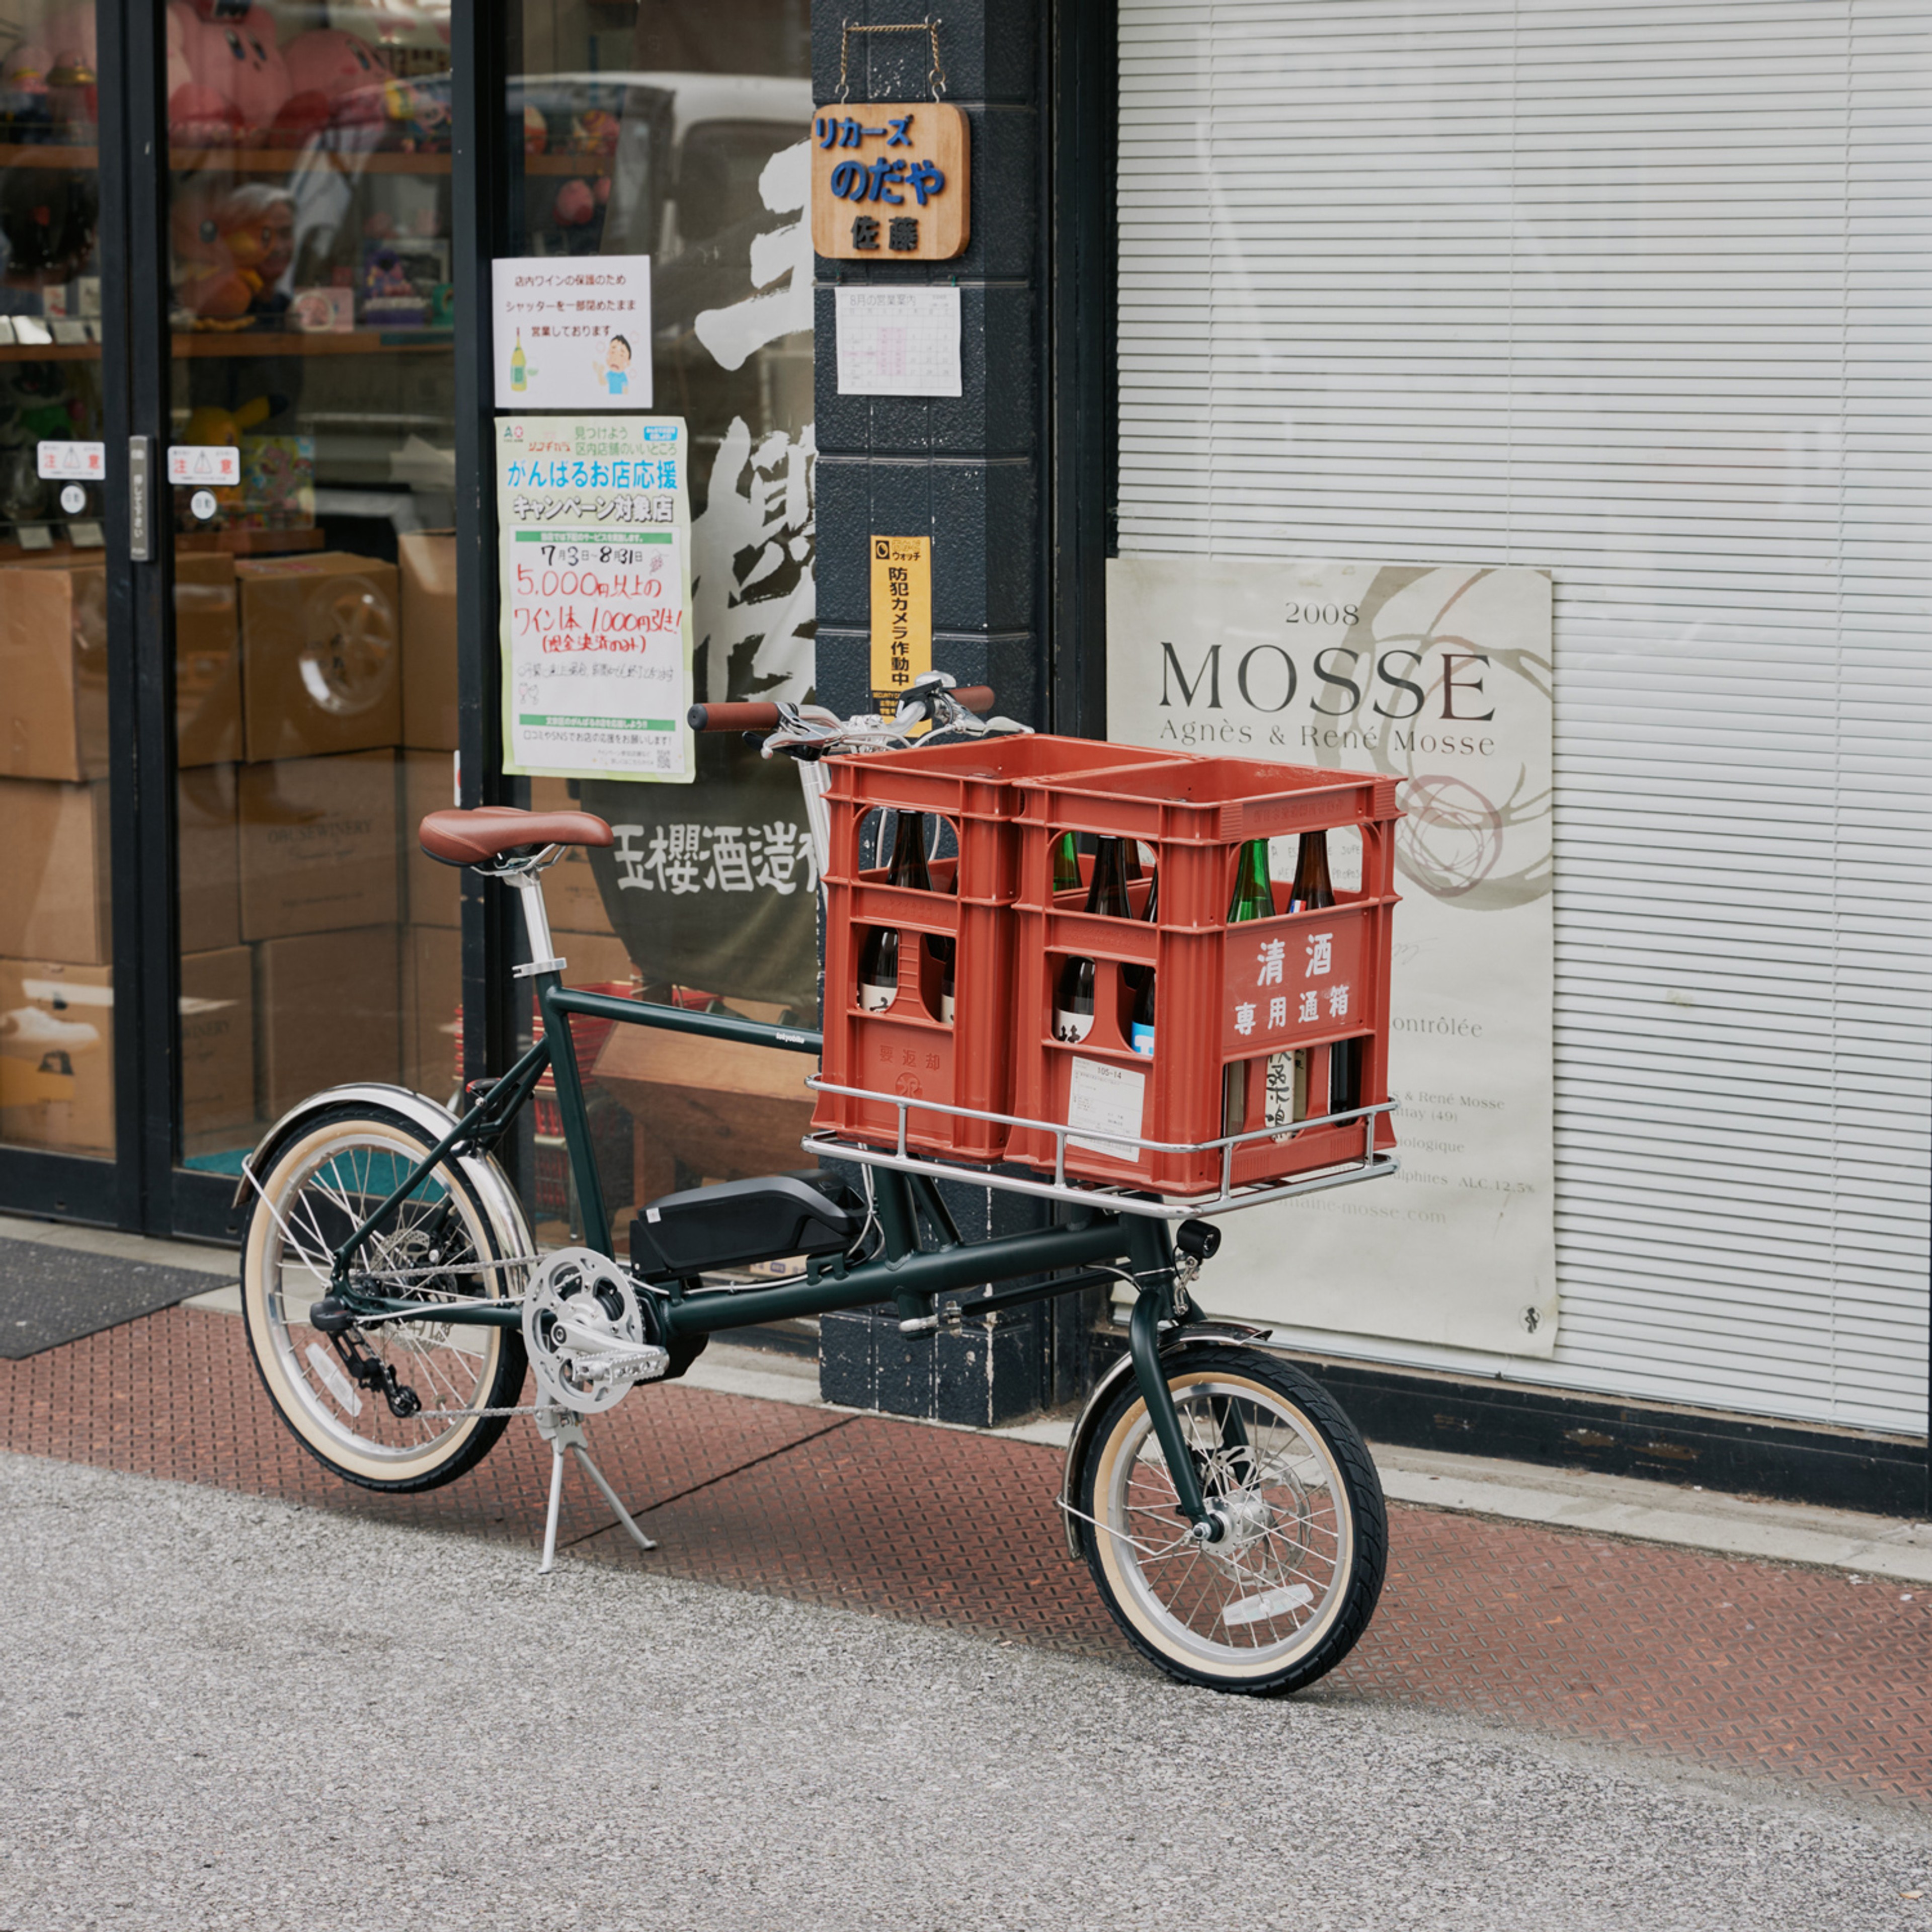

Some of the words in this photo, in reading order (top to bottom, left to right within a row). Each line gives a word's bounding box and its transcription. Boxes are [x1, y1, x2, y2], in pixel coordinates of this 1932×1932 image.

[816, 115, 914, 148] リカーズ
[831, 157, 945, 206] のだや
[851, 215, 919, 251] 佐藤
[515, 275, 626, 287] 店内ワインの保護のため
[506, 300, 636, 312] シャッターを一部閉めたまま
[531, 325, 611, 338] 営業しております
[575, 426, 628, 440] 見つけよう
[576, 443, 678, 456] 区内店舗のいいところ
[507, 460, 678, 490] がんばるお店応援
[513, 495, 673, 522] キャンペーン対象店
[889, 567, 909, 686] 防犯カメラ作動中
[1285, 602, 1360, 626] 2008
[1159, 641, 1496, 721] MOSSE
[1159, 718, 1252, 746] Agnès
[1269, 728, 1286, 746] &
[1301, 726, 1378, 750] René
[1394, 730, 1495, 756] Mosse
[1257, 933, 1333, 986] 清酒
[1234, 985, 1349, 1035] 専用通箱
[1390, 1016, 1483, 1037] ontrôlée
[879, 1044, 940, 1071] 要返却
[1097, 1066, 1122, 1079] 105-14
[1418, 1090, 1455, 1105] René
[1460, 1095, 1505, 1110] Mosse
[1431, 1110, 1459, 1123] (49)
[1397, 1137, 1465, 1154] iologique
[1390, 1168, 1448, 1186] ulphites
[1273, 1194, 1447, 1225] omaine-mosse.com
